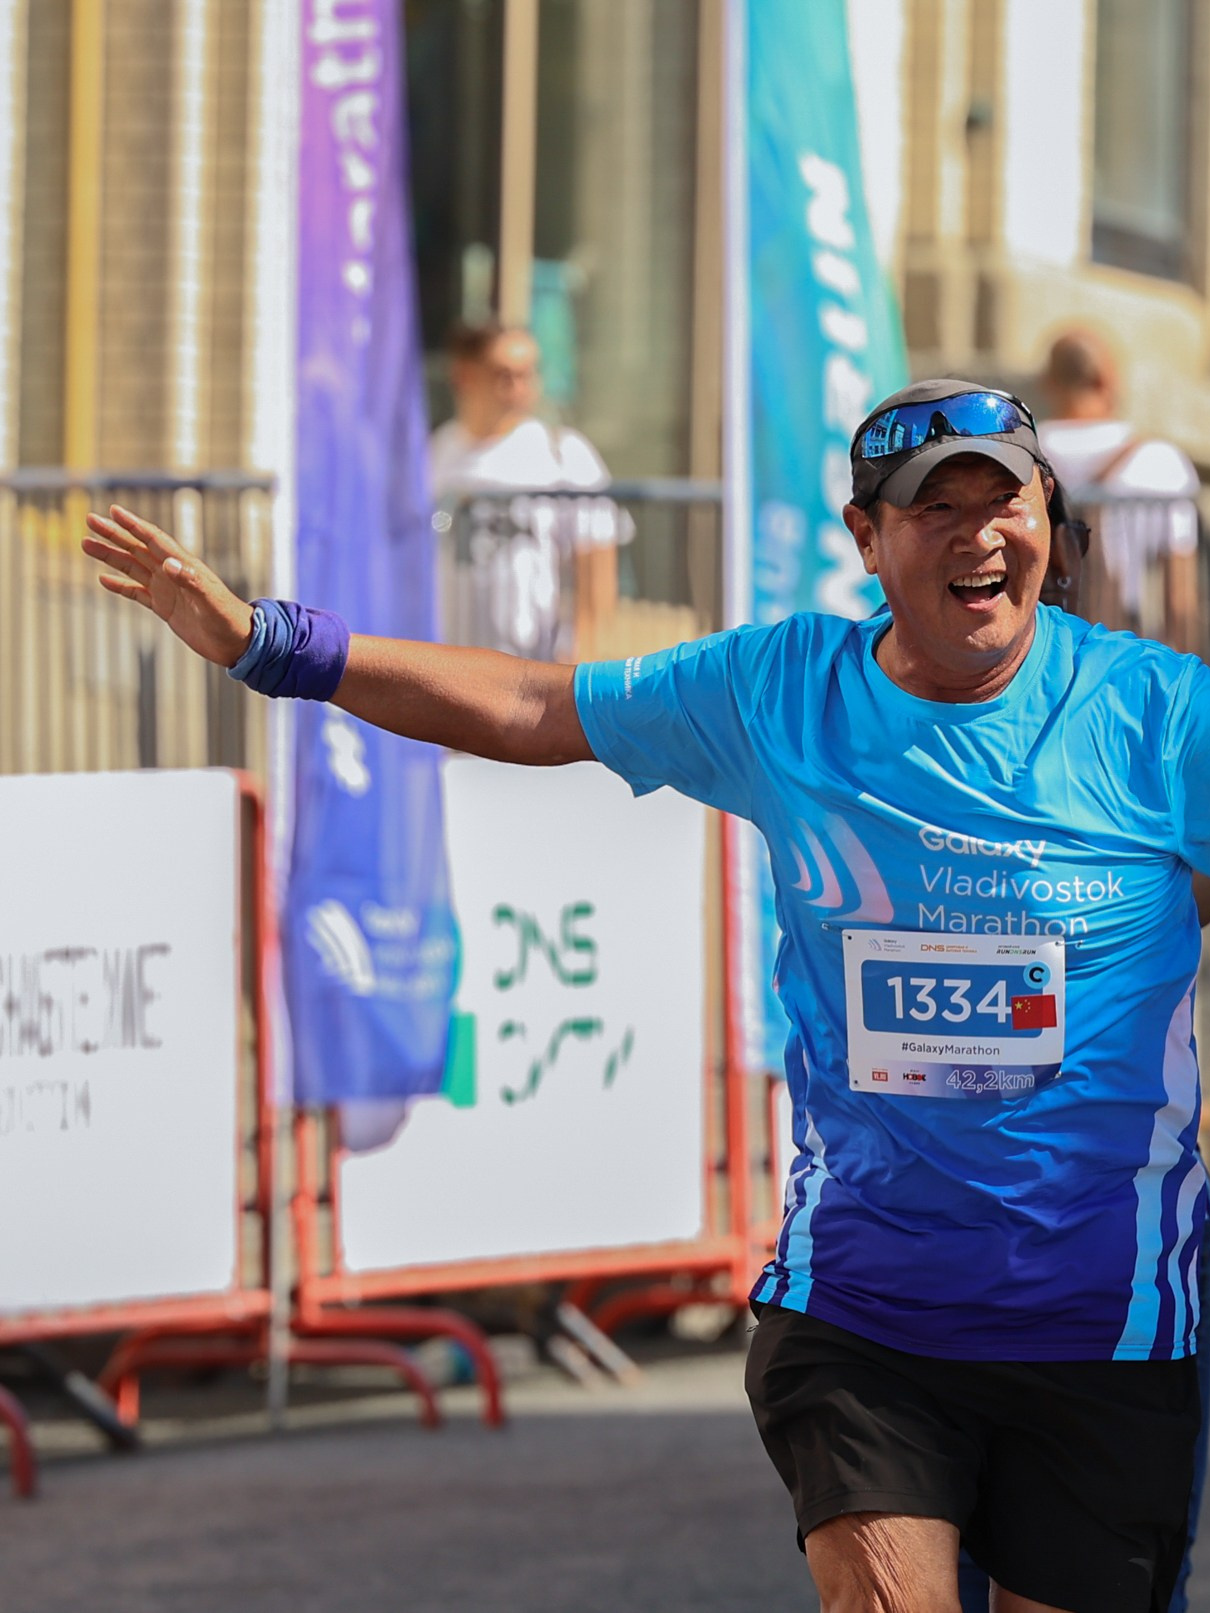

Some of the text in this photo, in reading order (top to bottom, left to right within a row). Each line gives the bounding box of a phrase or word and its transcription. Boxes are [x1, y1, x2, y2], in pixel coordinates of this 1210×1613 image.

[918, 825, 1046, 868] Galaxy
[920, 864, 1124, 903] Vladivostok
[918, 902, 1089, 937] Marathon
[920, 943, 945, 953] DNS
[1028, 966, 1045, 983] C
[886, 976, 1012, 1024] 1334
[901, 1042, 1001, 1056] #GalaxyMarathon
[945, 1069, 1035, 1094] 42,2km
